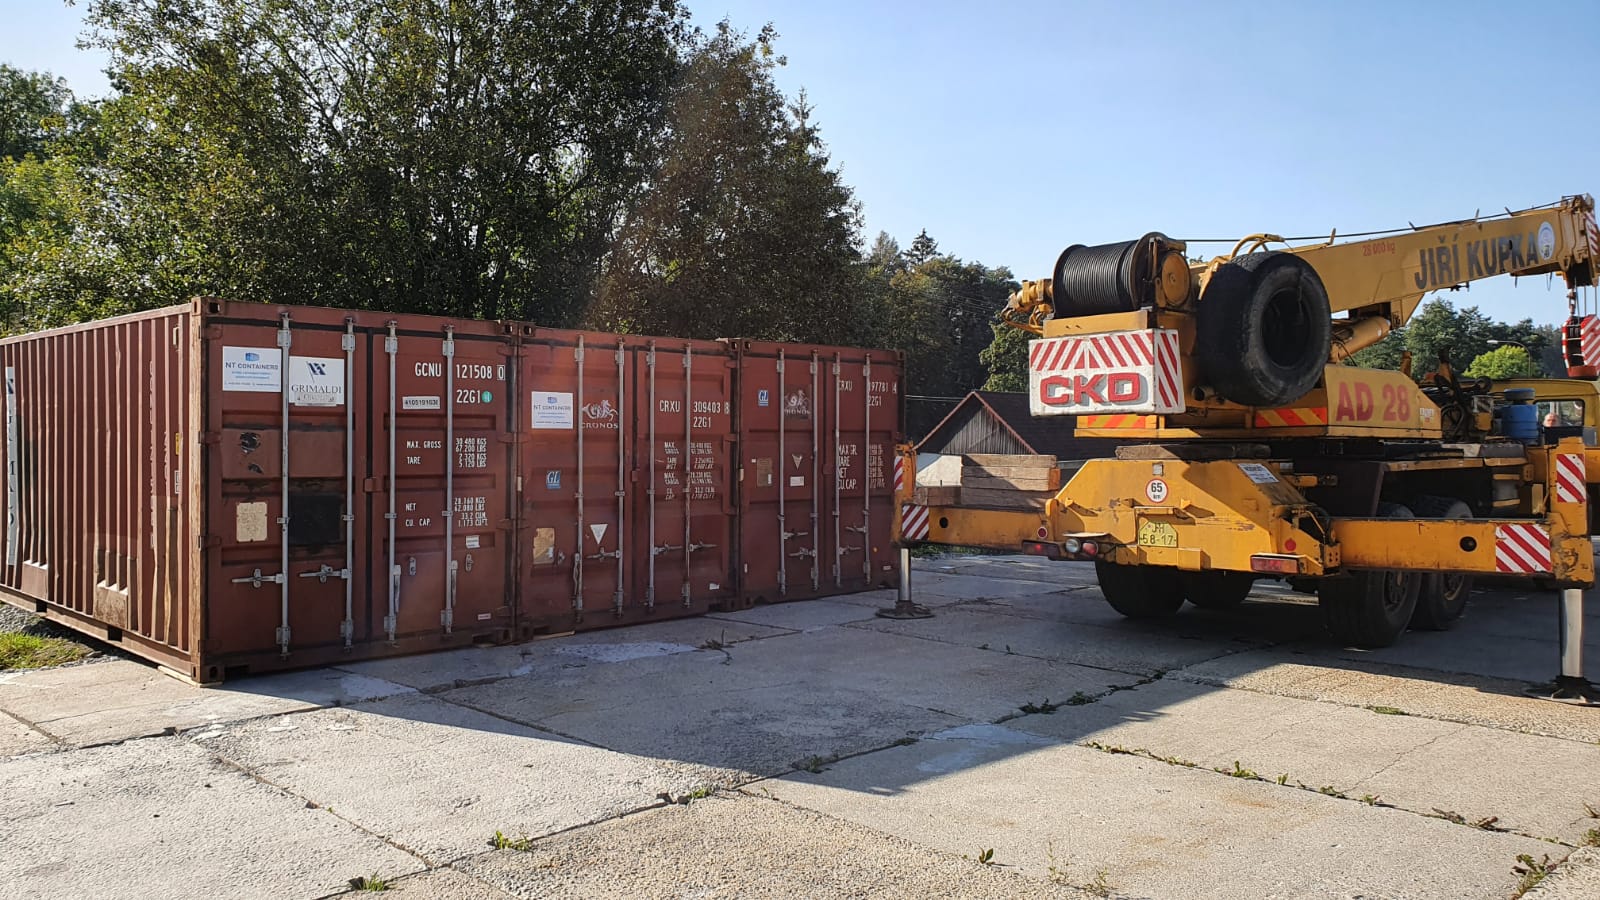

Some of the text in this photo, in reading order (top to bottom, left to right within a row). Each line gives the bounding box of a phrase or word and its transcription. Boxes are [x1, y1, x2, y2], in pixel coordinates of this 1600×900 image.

[1415, 231, 1539, 290] JIŘÍ KUPKA
[238, 363, 279, 371] CONTAINERS
[415, 362, 504, 379] GCNU 121508 0
[291, 383, 342, 394] GRIMALDI
[1040, 372, 1141, 407] CKD
[456, 389, 481, 404] 22G1
[1336, 382, 1410, 422] AD 28
[659, 400, 681, 413] CRXU
[693, 402, 720, 414] 309403
[693, 416, 711, 428] 22G1
[407, 440, 421, 449] MAX.
[424, 440, 442, 449] GROSS
[407, 456, 421, 465] TARE
[1151, 483, 1162, 492] 65
[406, 503, 416, 511] NET
